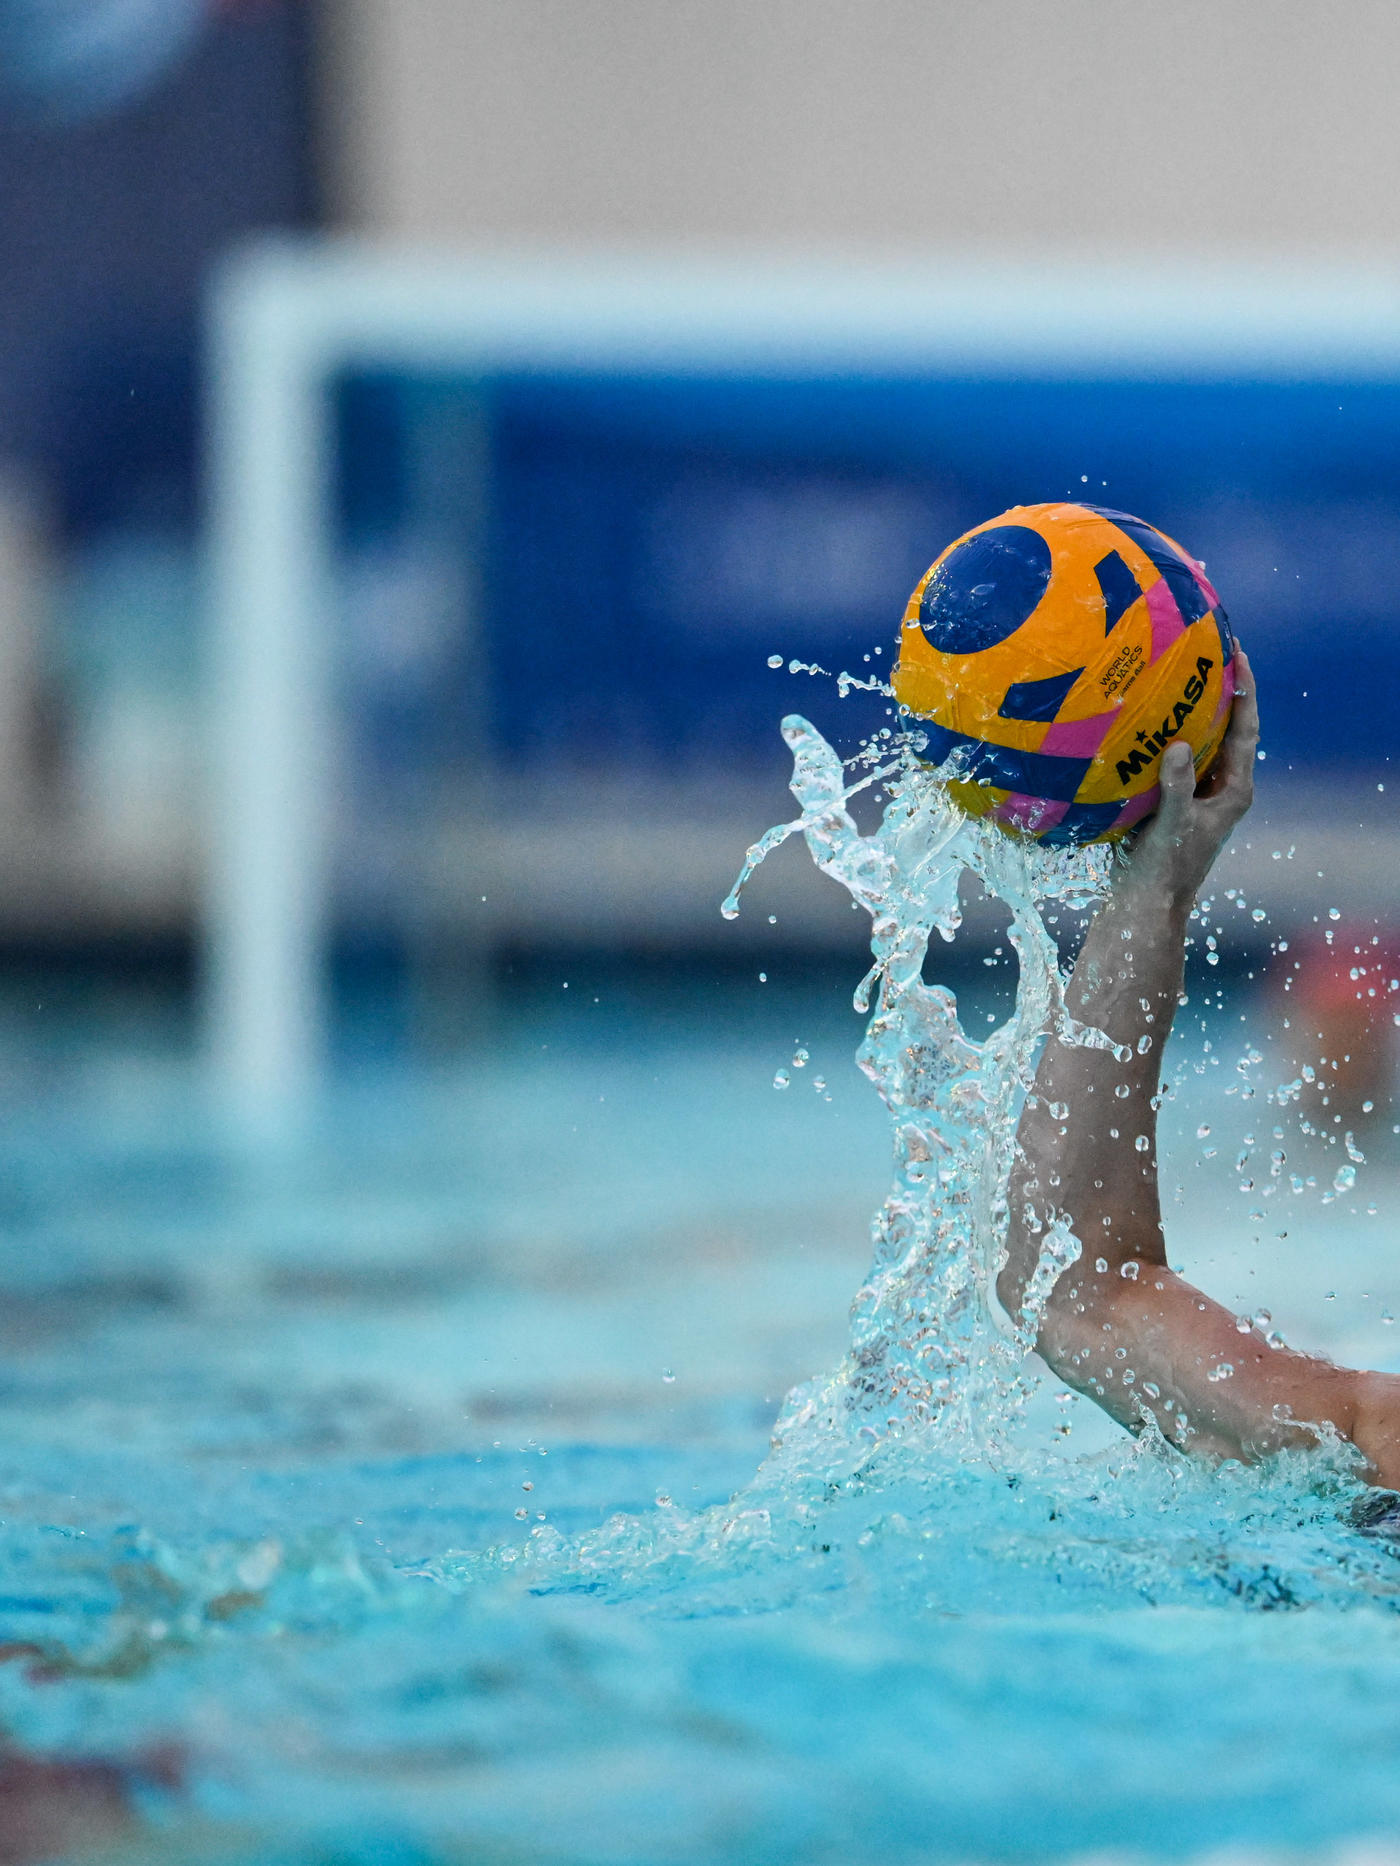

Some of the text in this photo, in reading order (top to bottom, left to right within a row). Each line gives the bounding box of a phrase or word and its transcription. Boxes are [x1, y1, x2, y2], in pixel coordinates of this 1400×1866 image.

[1100, 646, 1130, 686] WORLD
[1104, 645, 1143, 699] AQUATICS
[1115, 656, 1213, 786] MIKASA
